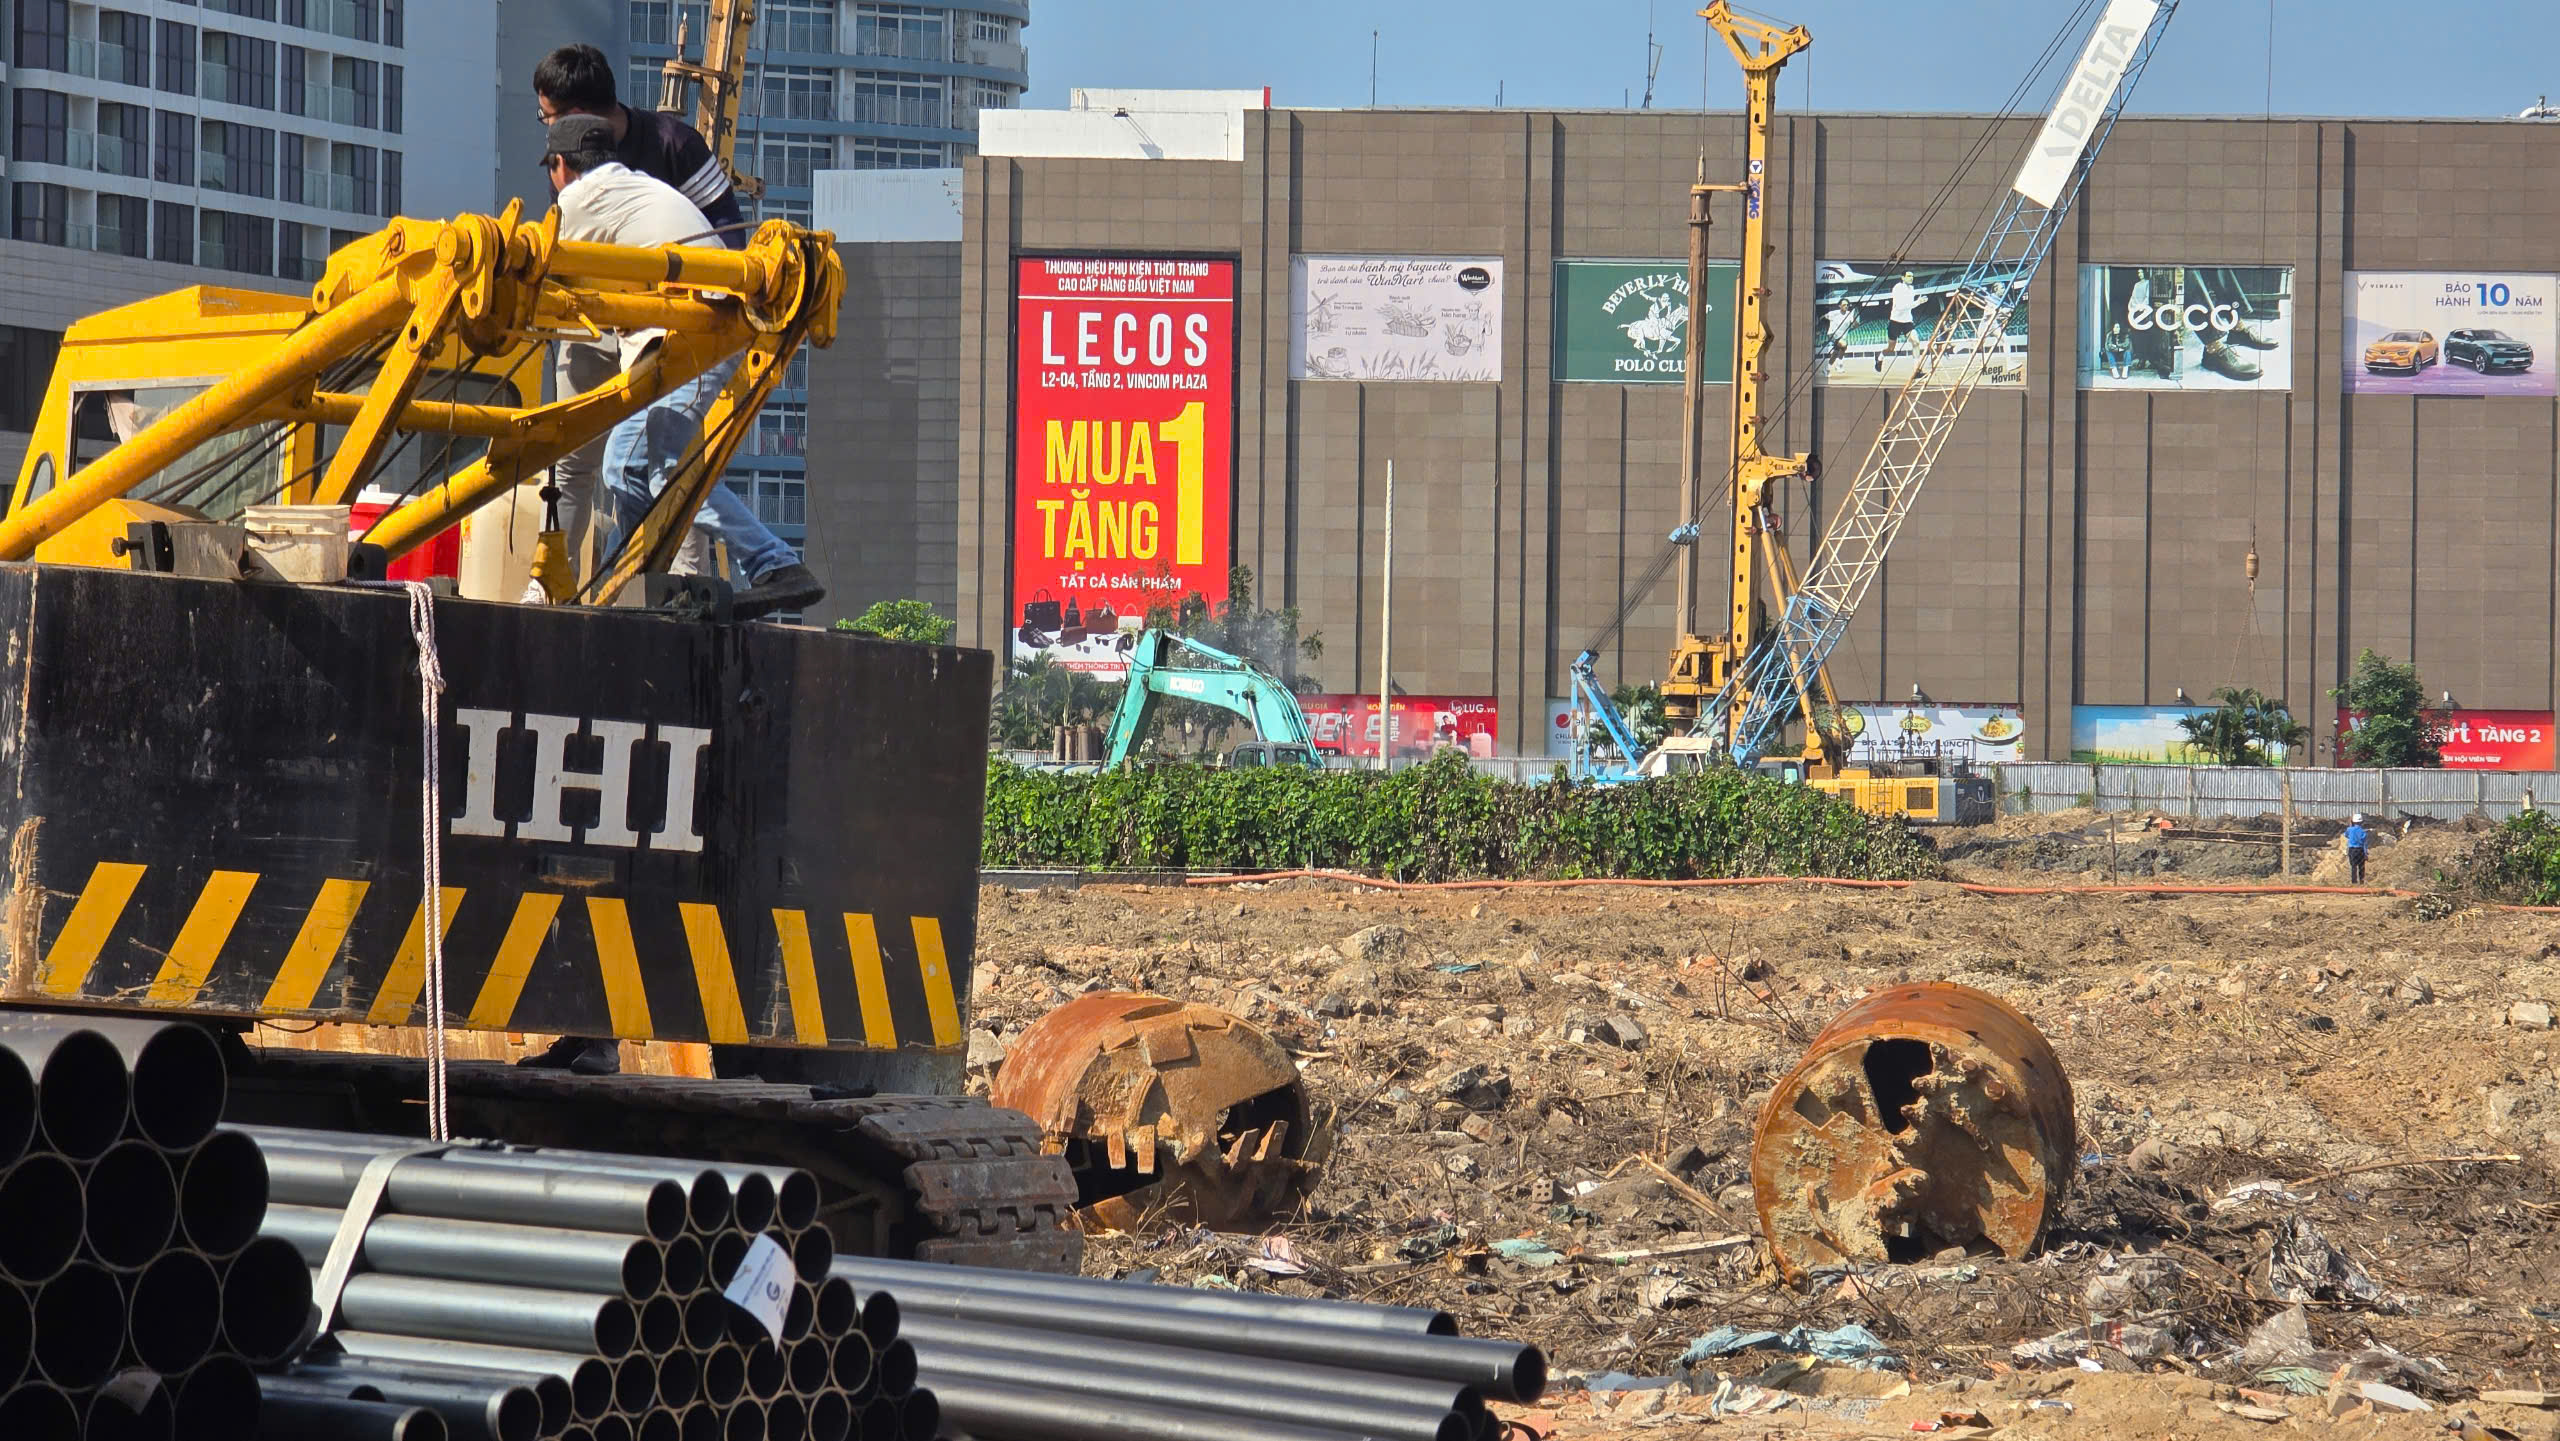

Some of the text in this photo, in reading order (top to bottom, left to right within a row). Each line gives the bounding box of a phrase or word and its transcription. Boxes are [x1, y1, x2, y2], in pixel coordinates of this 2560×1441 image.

[2055, 24, 2139, 140] DELTA
[1044, 259, 1209, 278] THƯƠNG HIỆU PHỤ KIỆN THỜI TRANG
[1406, 259, 1453, 276] baguette
[1058, 278, 1078, 292] CAO
[1079, 275, 1098, 292] CẤP
[1100, 276, 1126, 293] HÀNG
[1150, 278, 1171, 295] VIỆT
[1172, 279, 1195, 293] NAM
[1367, 273, 1424, 287] WinMart
[2445, 280, 2471, 293] BẢO
[1602, 274, 1668, 315] BEVERLY
[2435, 282, 2543, 307] HÀNH 10 NĂM
[2127, 302, 2240, 332] ecco
[1042, 311, 1208, 367] LECOS
[1614, 358, 1687, 373] POLO CLU
[1041, 371, 1079, 389] L2-04,
[1113, 373, 1124, 389] 2,
[1127, 373, 1170, 389] VINCOM
[1172, 374, 1208, 390] PLAZA
[1046, 401, 1205, 565] MUA 1
[1036, 488, 1159, 571] TẶNG
[1089, 572, 1109, 589] CẢ
[1110, 572, 1138, 589] SẢN
[2478, 725, 2526, 743] TẦNG
[2529, 729, 2541, 743] 2
[450, 707, 712, 853] IHI
